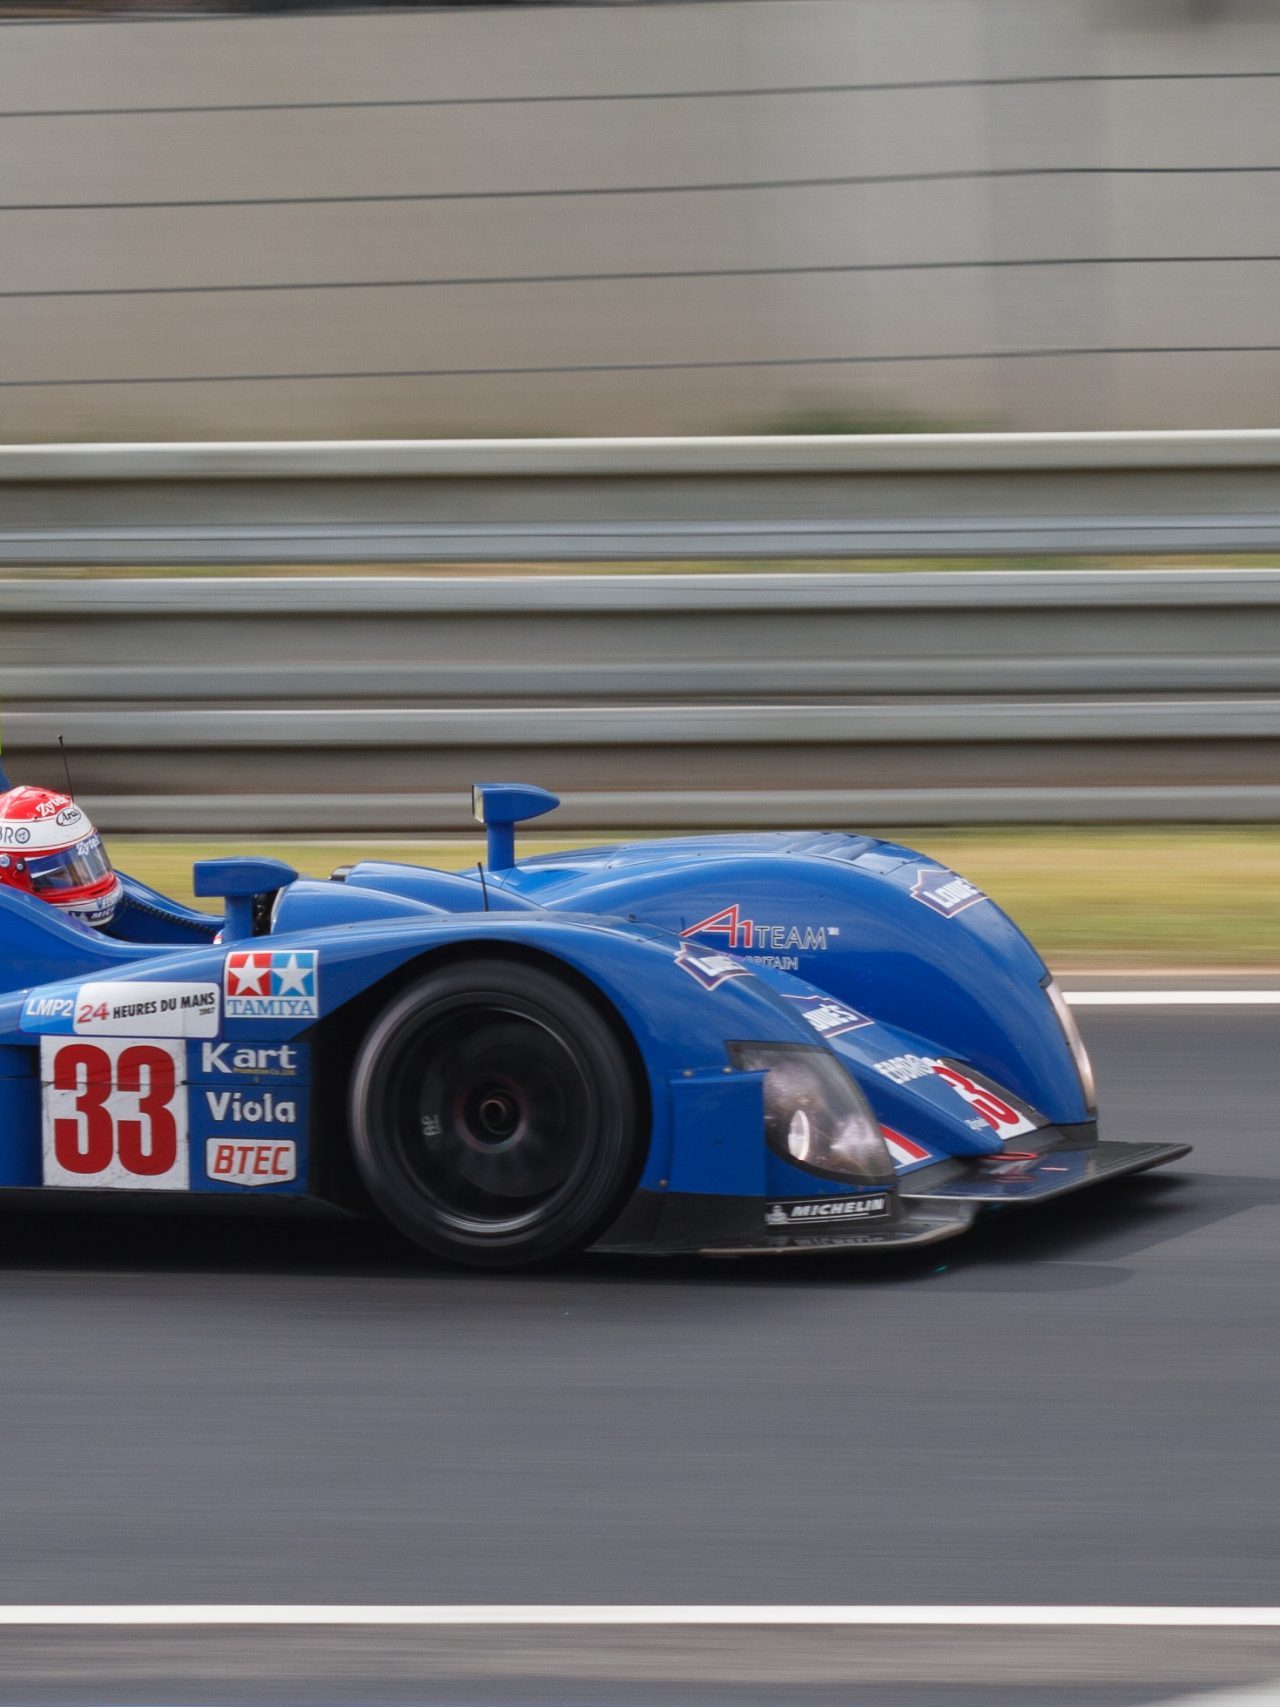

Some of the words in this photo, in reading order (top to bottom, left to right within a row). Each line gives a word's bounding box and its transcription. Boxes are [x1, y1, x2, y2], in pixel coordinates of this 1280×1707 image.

[26, 1000, 74, 1017] LMP2
[76, 1002, 110, 1024] 24
[112, 999, 157, 1020] HEURES
[160, 997, 177, 1012] DU
[180, 991, 216, 1009] MANS
[227, 1000, 315, 1016] TAMIYA
[202, 1042, 297, 1074] Kart
[53, 1043, 177, 1176] 33
[206, 1091, 296, 1123] Viola
[214, 1144, 290, 1176] BTEC
[791, 1199, 886, 1217] MICHELIN
